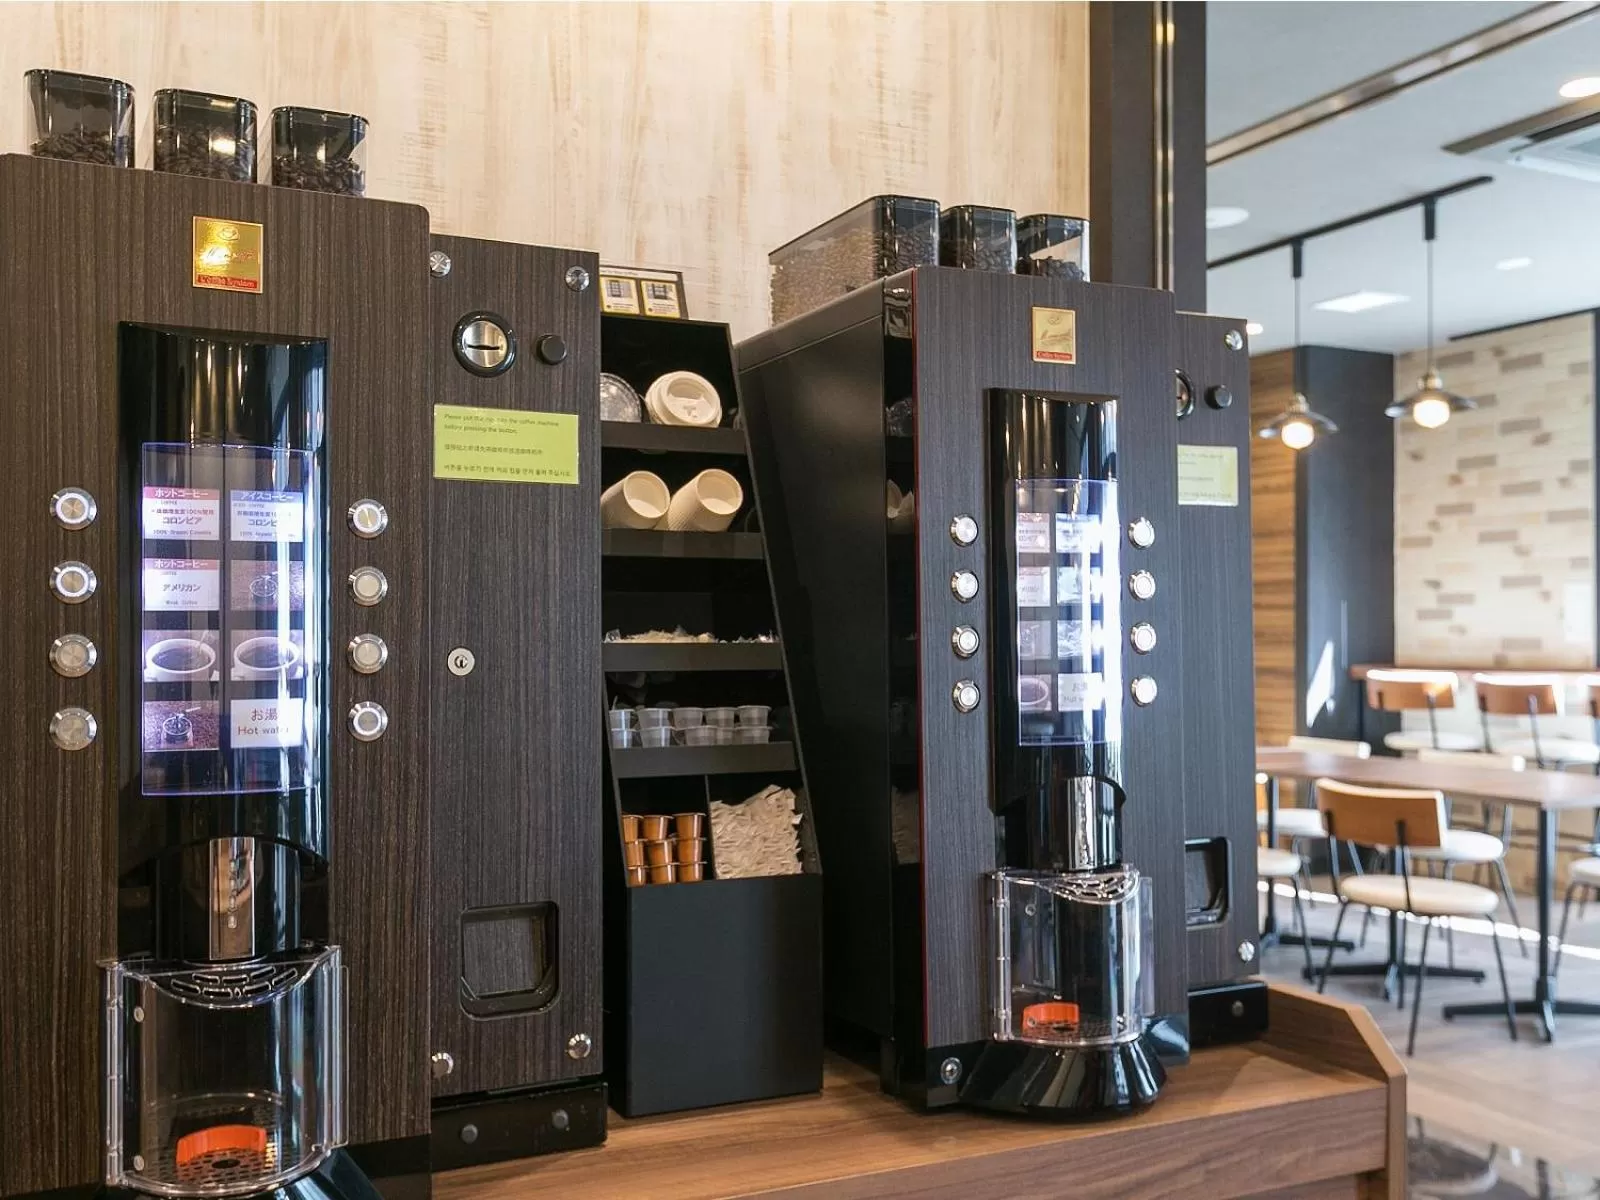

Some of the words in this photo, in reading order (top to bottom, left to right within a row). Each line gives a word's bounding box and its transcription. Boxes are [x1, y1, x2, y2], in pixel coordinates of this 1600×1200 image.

[154, 488, 209, 499] ホットコーヒー
[163, 516, 203, 526] コロンビア
[154, 559, 209, 569] ホットコーヒー
[163, 583, 202, 592] アメリカン
[238, 725, 259, 736] Hot
